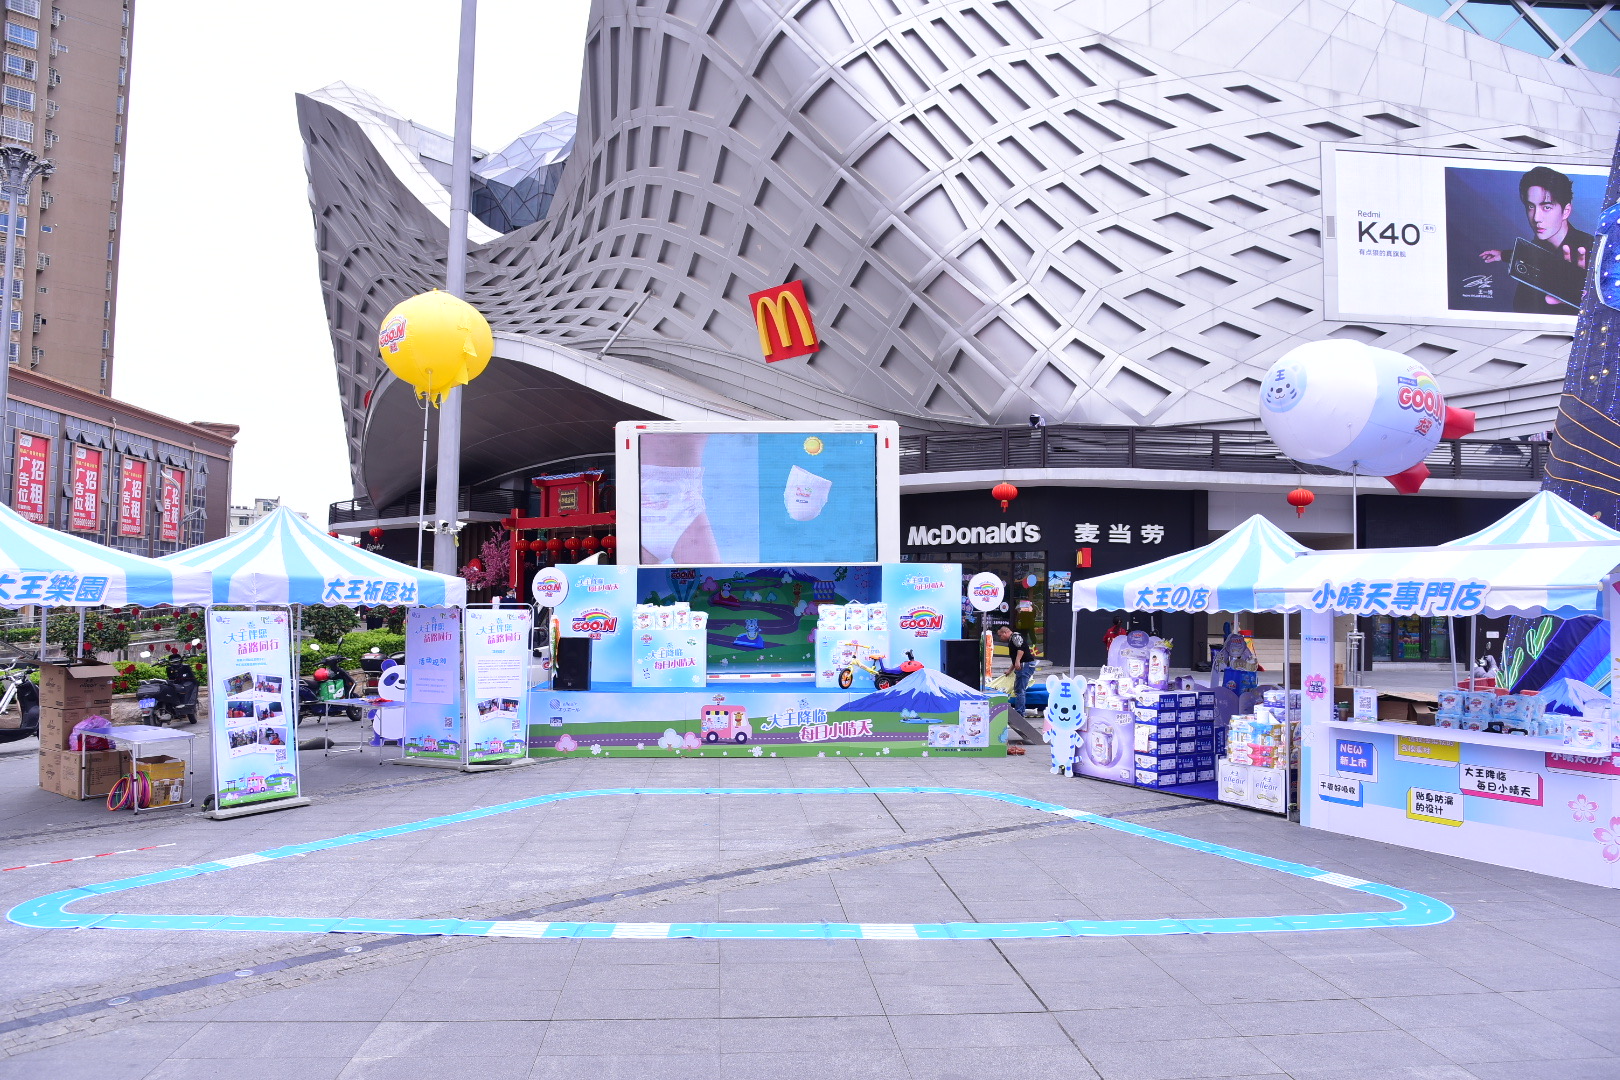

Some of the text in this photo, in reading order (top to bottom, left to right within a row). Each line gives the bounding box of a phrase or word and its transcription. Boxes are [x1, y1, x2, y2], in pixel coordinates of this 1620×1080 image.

[1357, 209, 1381, 218] Redmi
[1357, 221, 1421, 246] K40
[907, 521, 1042, 546] McDonald's
[1074, 522, 1165, 545] 麦当劳
[325, 577, 417, 602] 大王祈愿社
[1135, 586, 1210, 610] 大王の店
[1312, 580, 1487, 612] 小晴天專門店
[572, 616, 618, 632] GOO.N
[900, 614, 944, 630] GOO.N
[223, 628, 268, 644] 大王伴您
[761, 708, 828, 730] 大王降临
[798, 719, 874, 743] 每日小晴天
[1340, 744, 1363, 755] NEW
[1339, 756, 1368, 768] 新上市
[1464, 768, 1507, 782] 大王降临
[1476, 780, 1532, 798] 每日小晴天
[1416, 792, 1454, 806] 贴身防漏
[1416, 802, 1444, 816] 的设计
